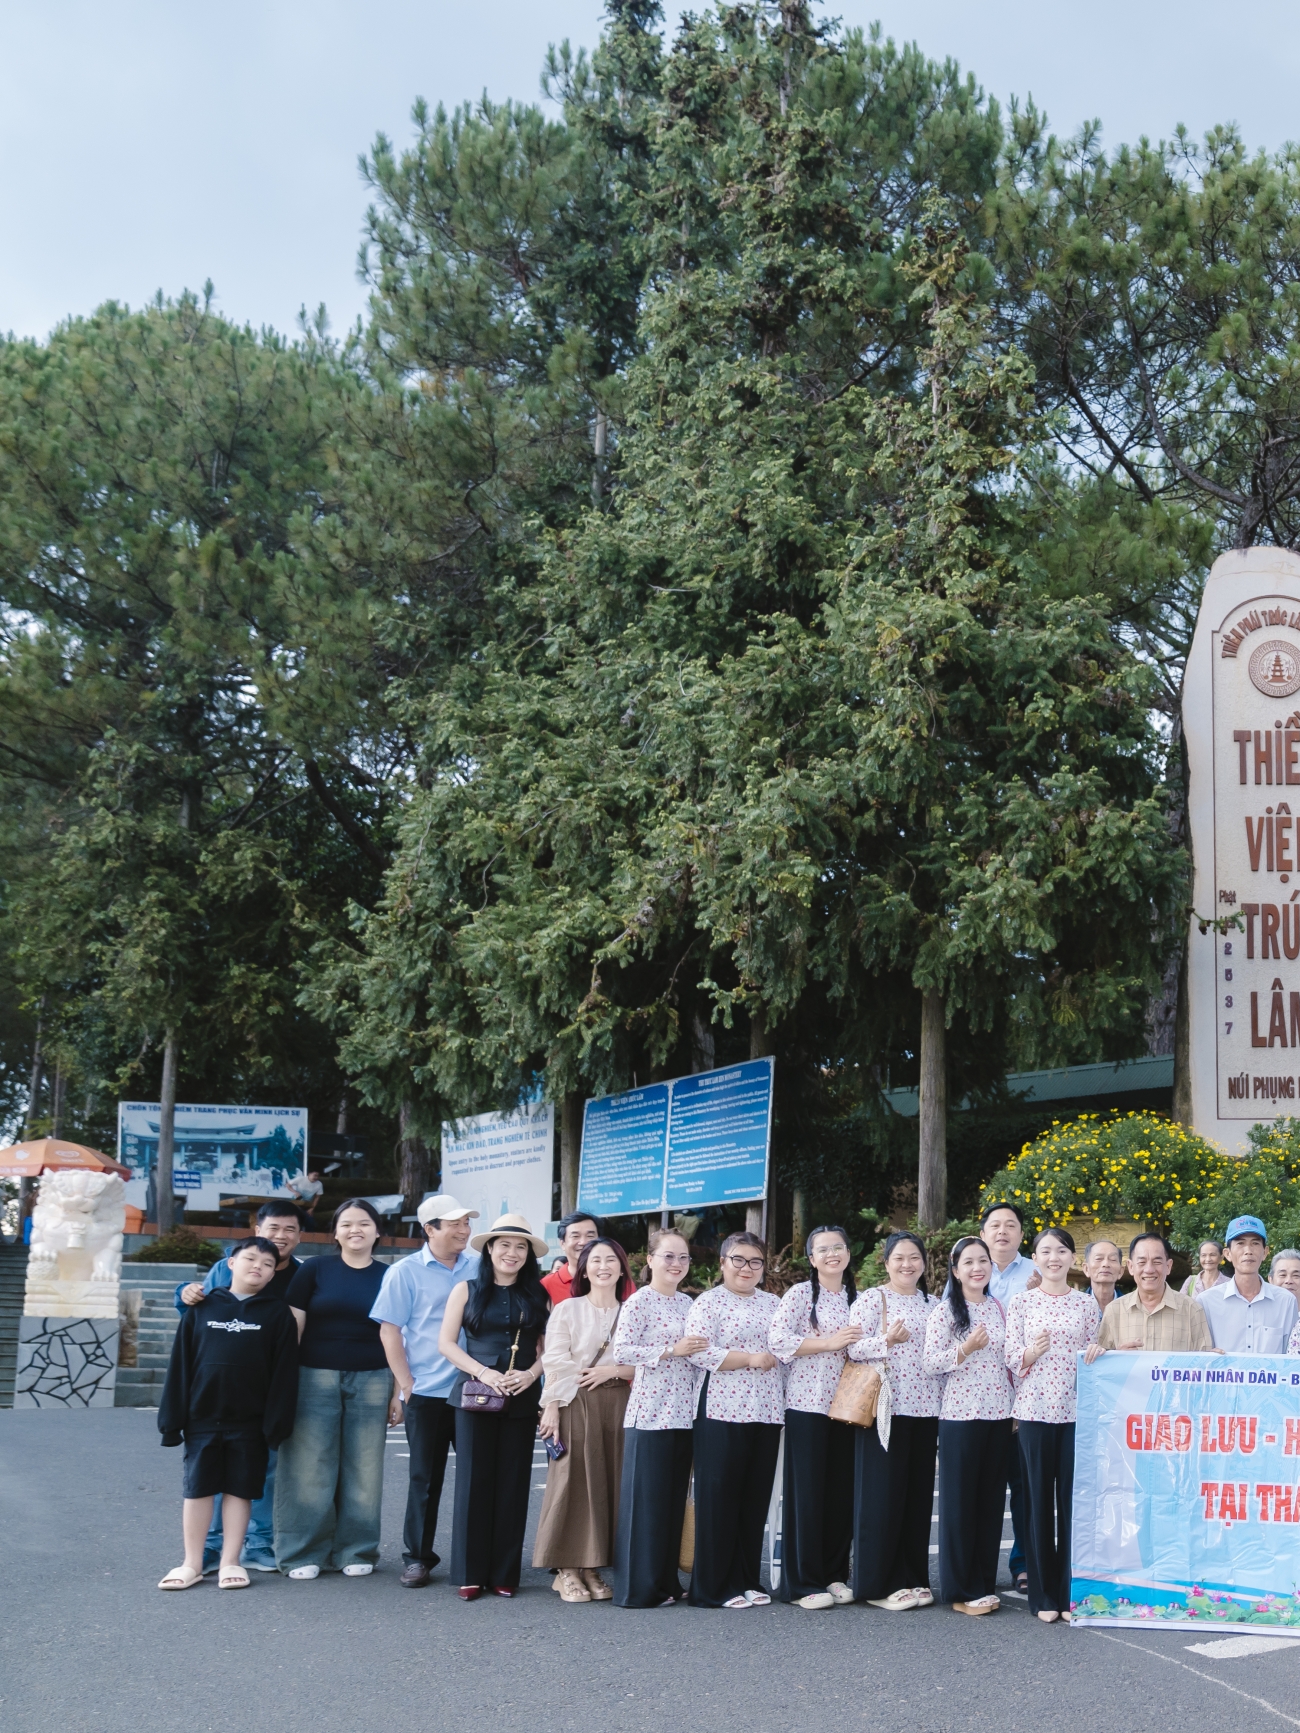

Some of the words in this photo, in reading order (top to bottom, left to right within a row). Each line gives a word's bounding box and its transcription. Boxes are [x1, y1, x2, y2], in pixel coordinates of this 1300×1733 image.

[1237, 609, 1262, 636] PHÁI
[1261, 606, 1287, 626] TRÚC
[1219, 889, 1237, 906] Phật
[1228, 1071, 1250, 1099] NÚI
[1253, 1076, 1295, 1104] PHỤNG
[1151, 1366, 1169, 1381] ỦY
[1172, 1369, 1202, 1382] BAN
[1205, 1368, 1244, 1383] NHÂN
[1248, 1370, 1277, 1385] DÂN
[1126, 1414, 1192, 1452] GIAO
[1200, 1415, 1258, 1454] LƯU
[1201, 1482, 1248, 1527] TẠI
